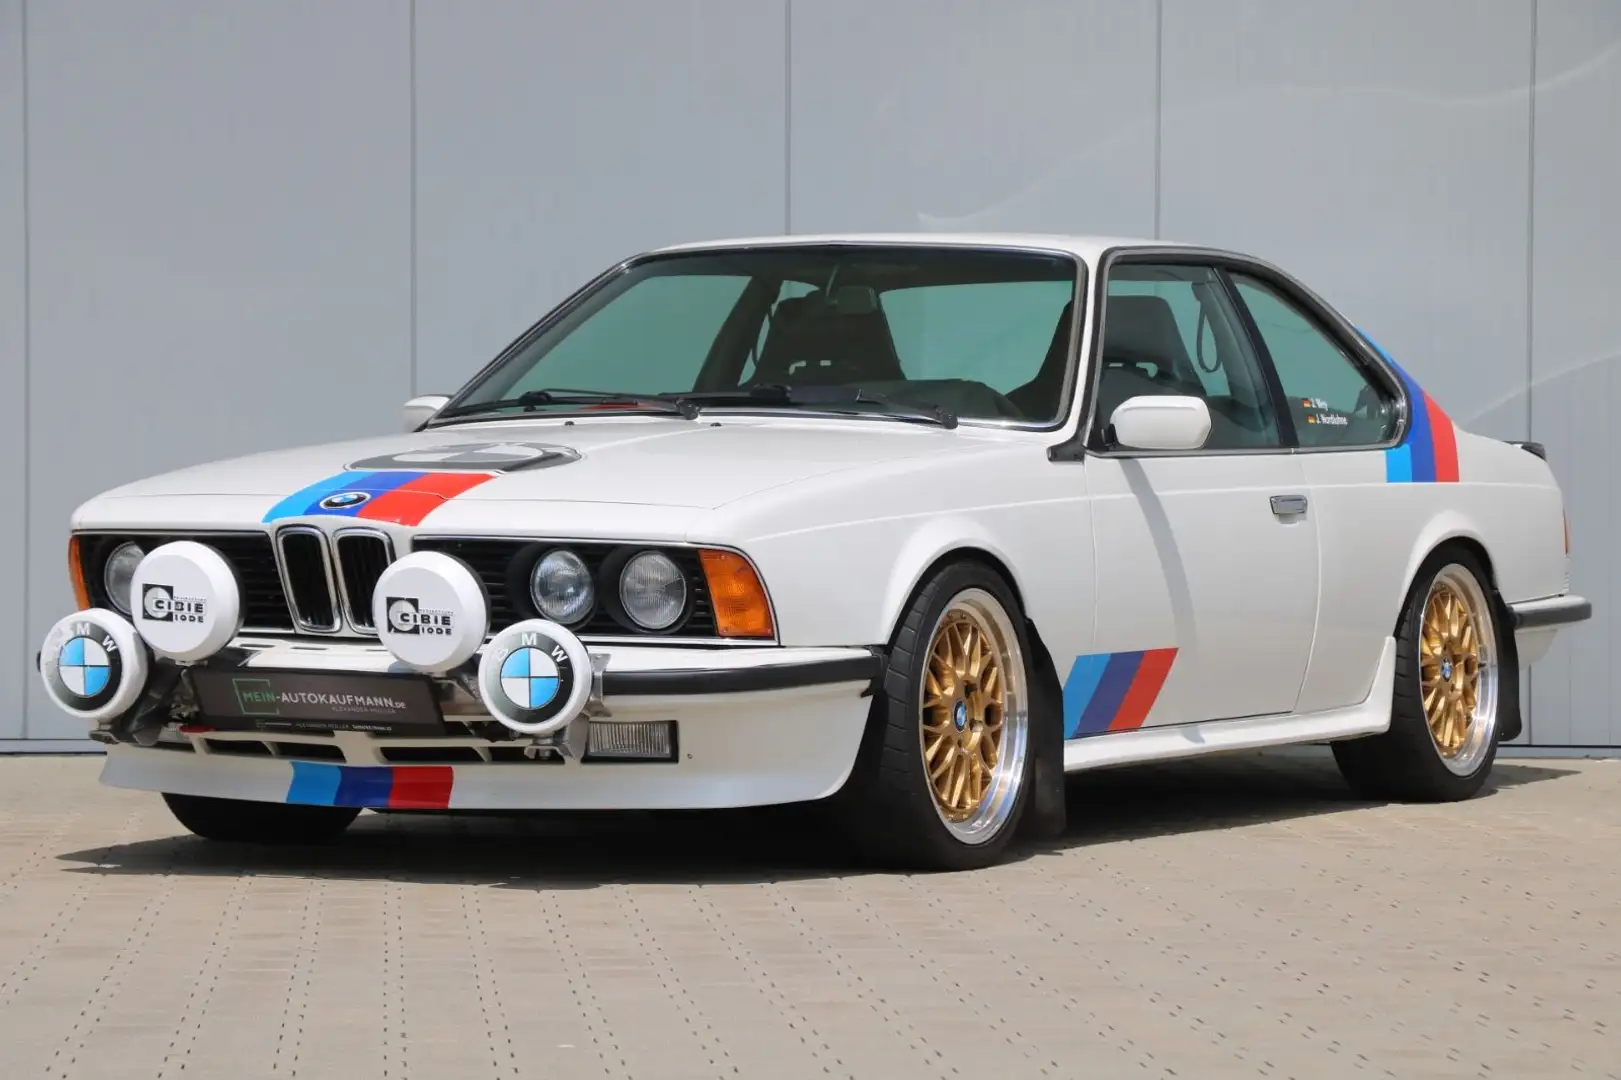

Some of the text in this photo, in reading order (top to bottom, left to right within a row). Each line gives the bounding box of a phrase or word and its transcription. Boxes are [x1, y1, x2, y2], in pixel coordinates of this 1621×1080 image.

[154, 599, 204, 613] CIBIE
[175, 614, 204, 623] IODE
[399, 612, 451, 626] CIBIE
[421, 626, 452, 636] IODE
